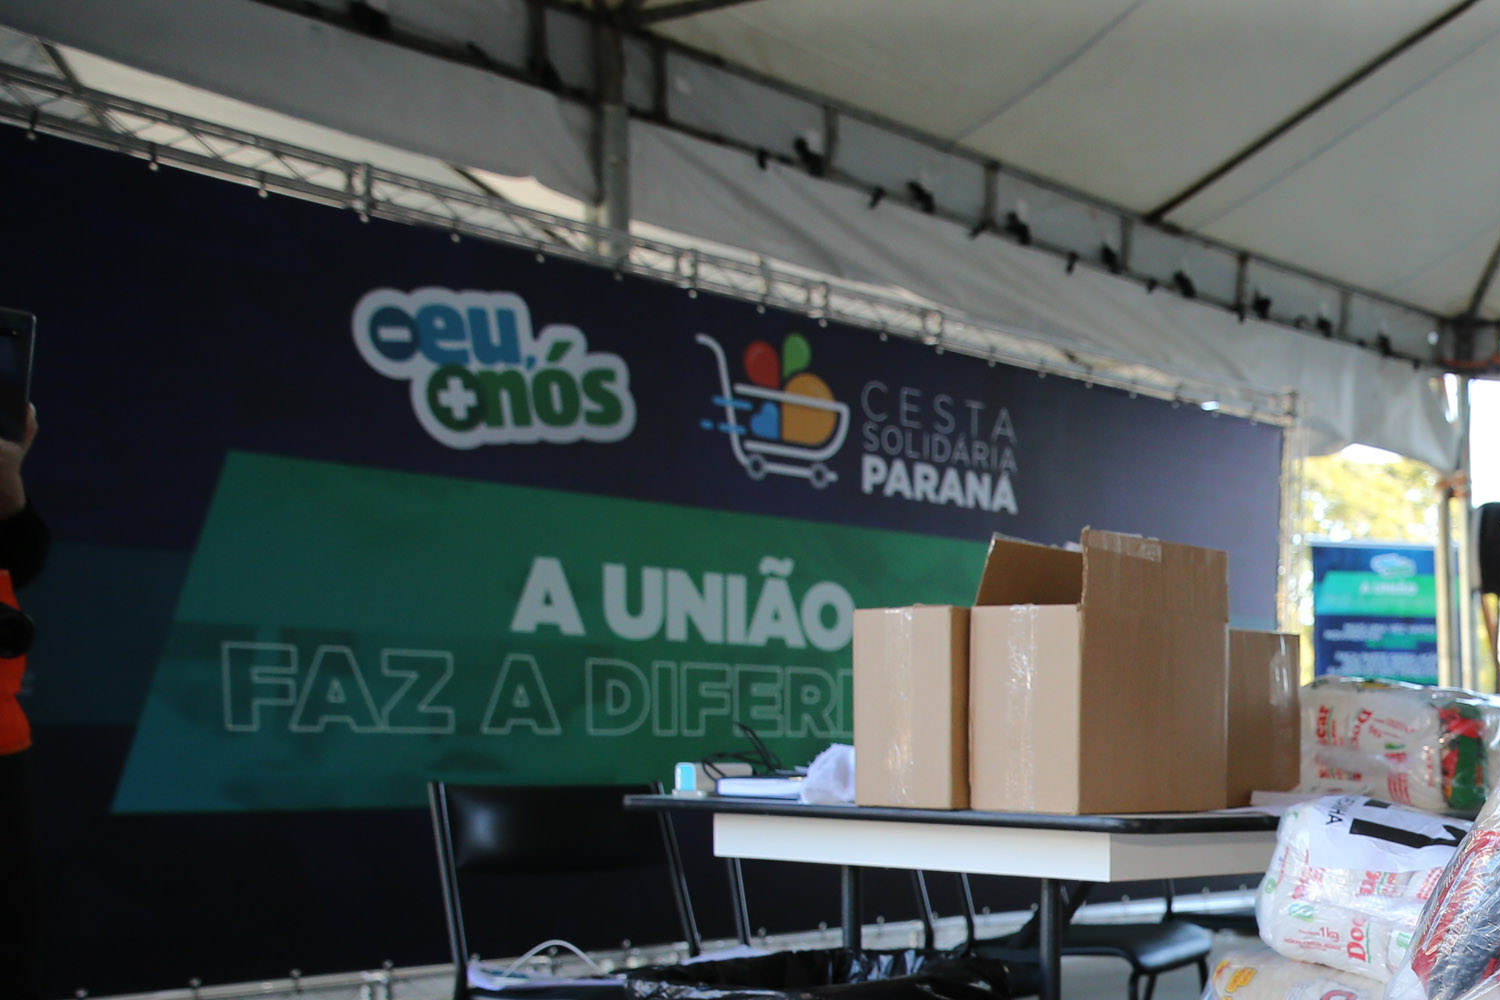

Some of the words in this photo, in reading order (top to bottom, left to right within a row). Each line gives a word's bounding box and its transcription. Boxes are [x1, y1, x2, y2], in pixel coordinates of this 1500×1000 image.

[861, 381, 1018, 444] CESTA
[862, 421, 1018, 473] SOLIDÁRIA
[861, 453, 1018, 514] PARANÁ
[510, 557, 586, 637] A
[603, 555, 856, 652] UNIÃO
[221, 640, 455, 734] FAZ
[480, 653, 562, 736] A
[585, 657, 854, 738] DIFER
